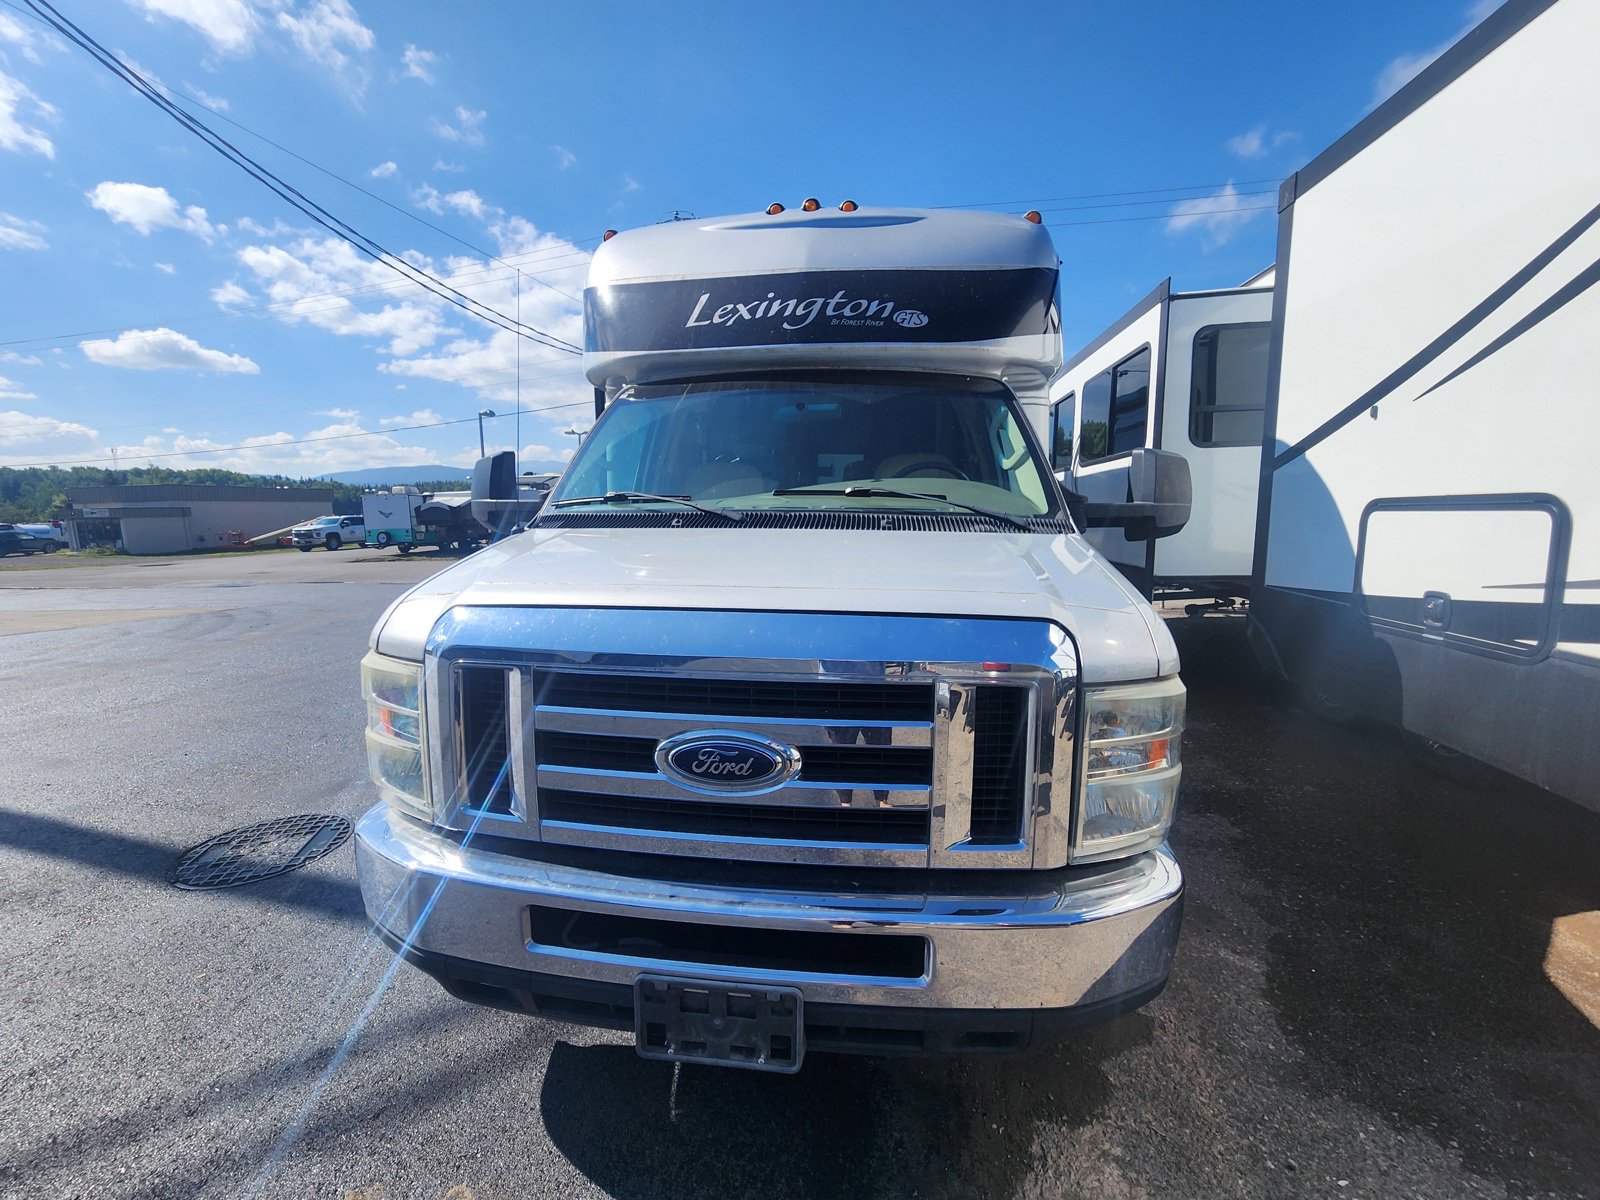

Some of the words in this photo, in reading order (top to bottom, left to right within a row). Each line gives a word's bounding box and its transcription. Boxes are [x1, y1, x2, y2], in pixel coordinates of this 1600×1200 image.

[685, 290, 895, 330] Lexington
[895, 311, 927, 327] GTS
[840, 318, 865, 327] FOREST
[865, 319, 885, 327] RIVER
[691, 748, 754, 776] Ford
